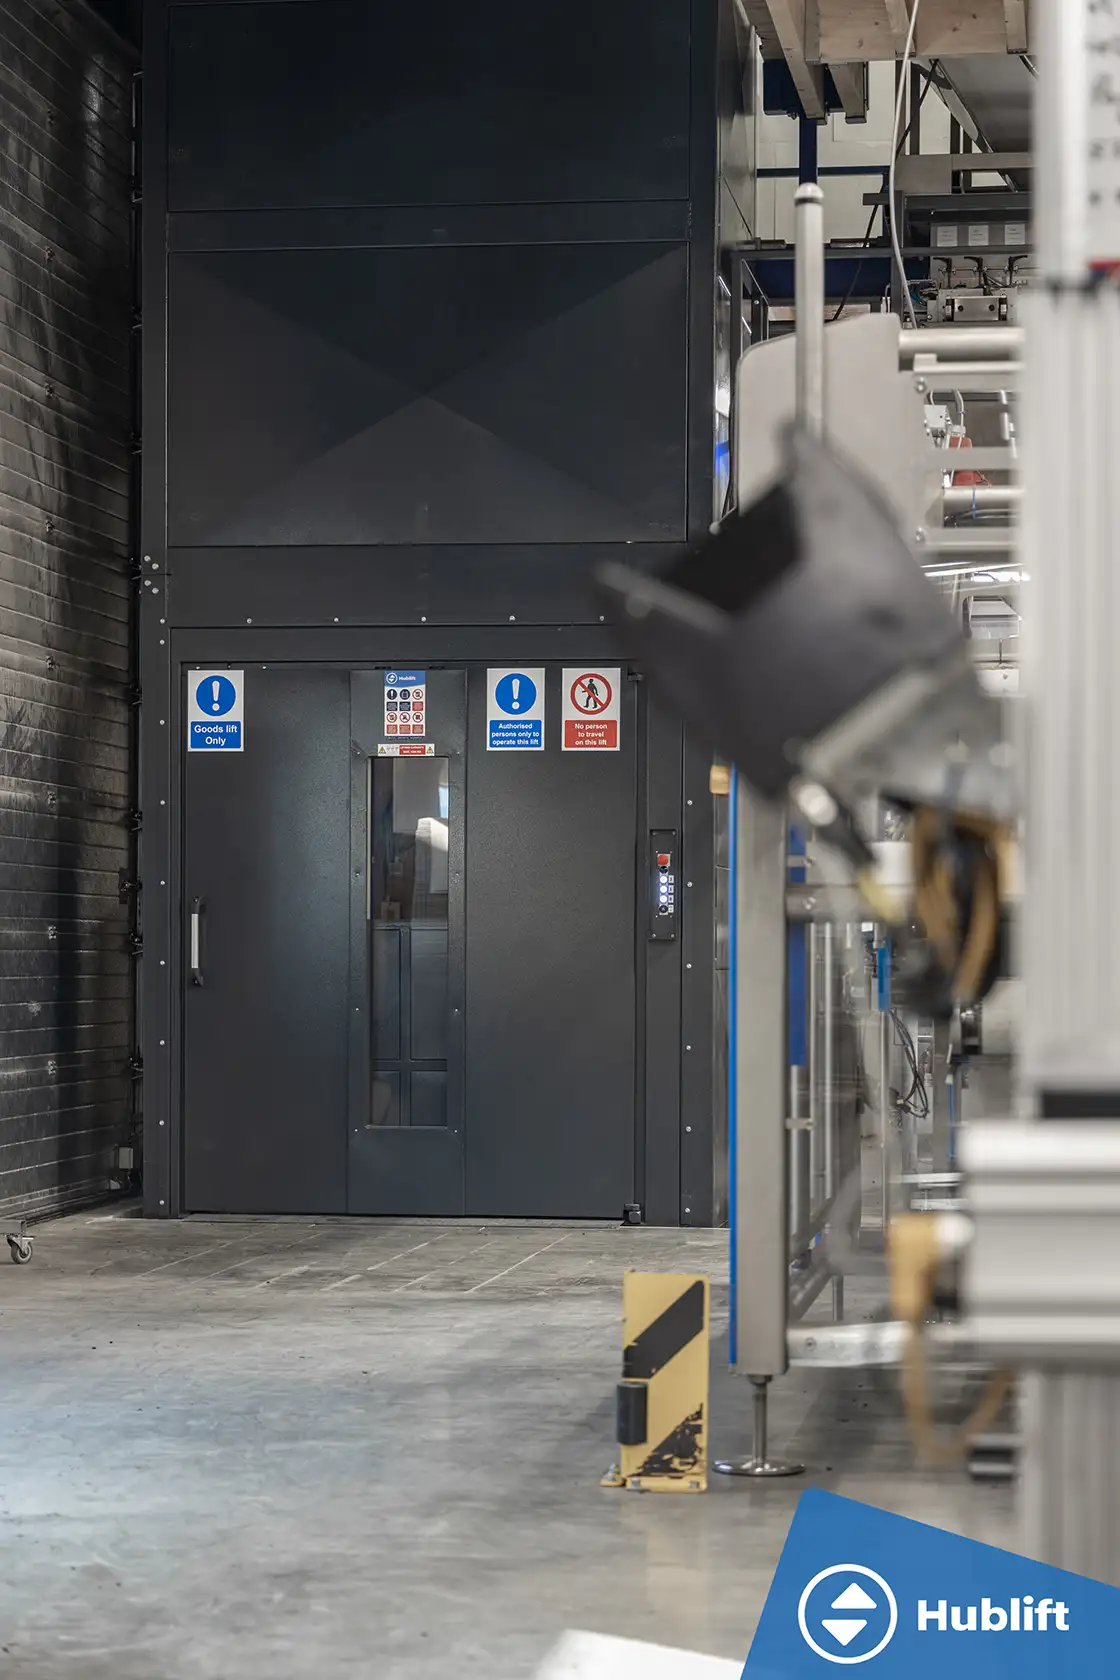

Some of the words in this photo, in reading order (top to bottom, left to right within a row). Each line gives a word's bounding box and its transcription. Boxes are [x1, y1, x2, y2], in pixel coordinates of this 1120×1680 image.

[194, 724, 224, 733] Goods
[226, 724, 238, 732] lift
[206, 736, 226, 746] Only
